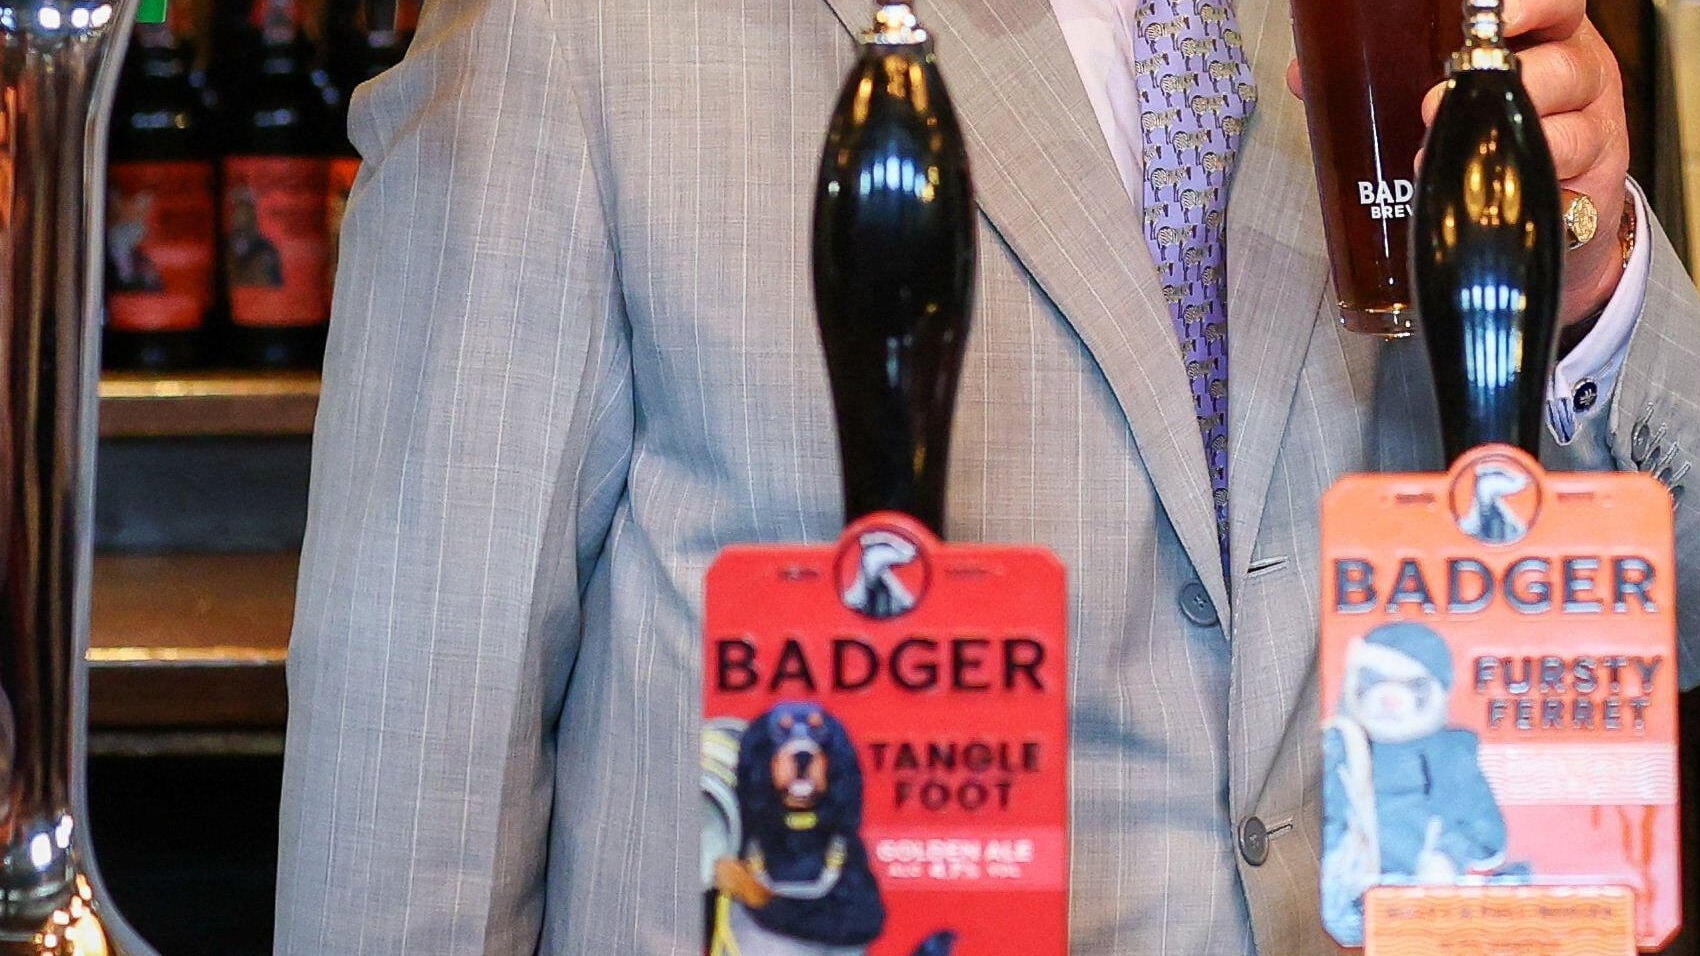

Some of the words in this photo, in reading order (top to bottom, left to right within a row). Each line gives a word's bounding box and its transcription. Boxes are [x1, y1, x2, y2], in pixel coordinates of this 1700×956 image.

[1357, 179, 1414, 205] BAD
[1334, 555, 1659, 615] BADGER
[715, 636, 1046, 694] BADGER
[1475, 655, 1663, 694] FURSTY
[1488, 696, 1652, 734] FERRET
[870, 741, 1041, 773] TANGLE
[894, 780, 1012, 812] FOOT
